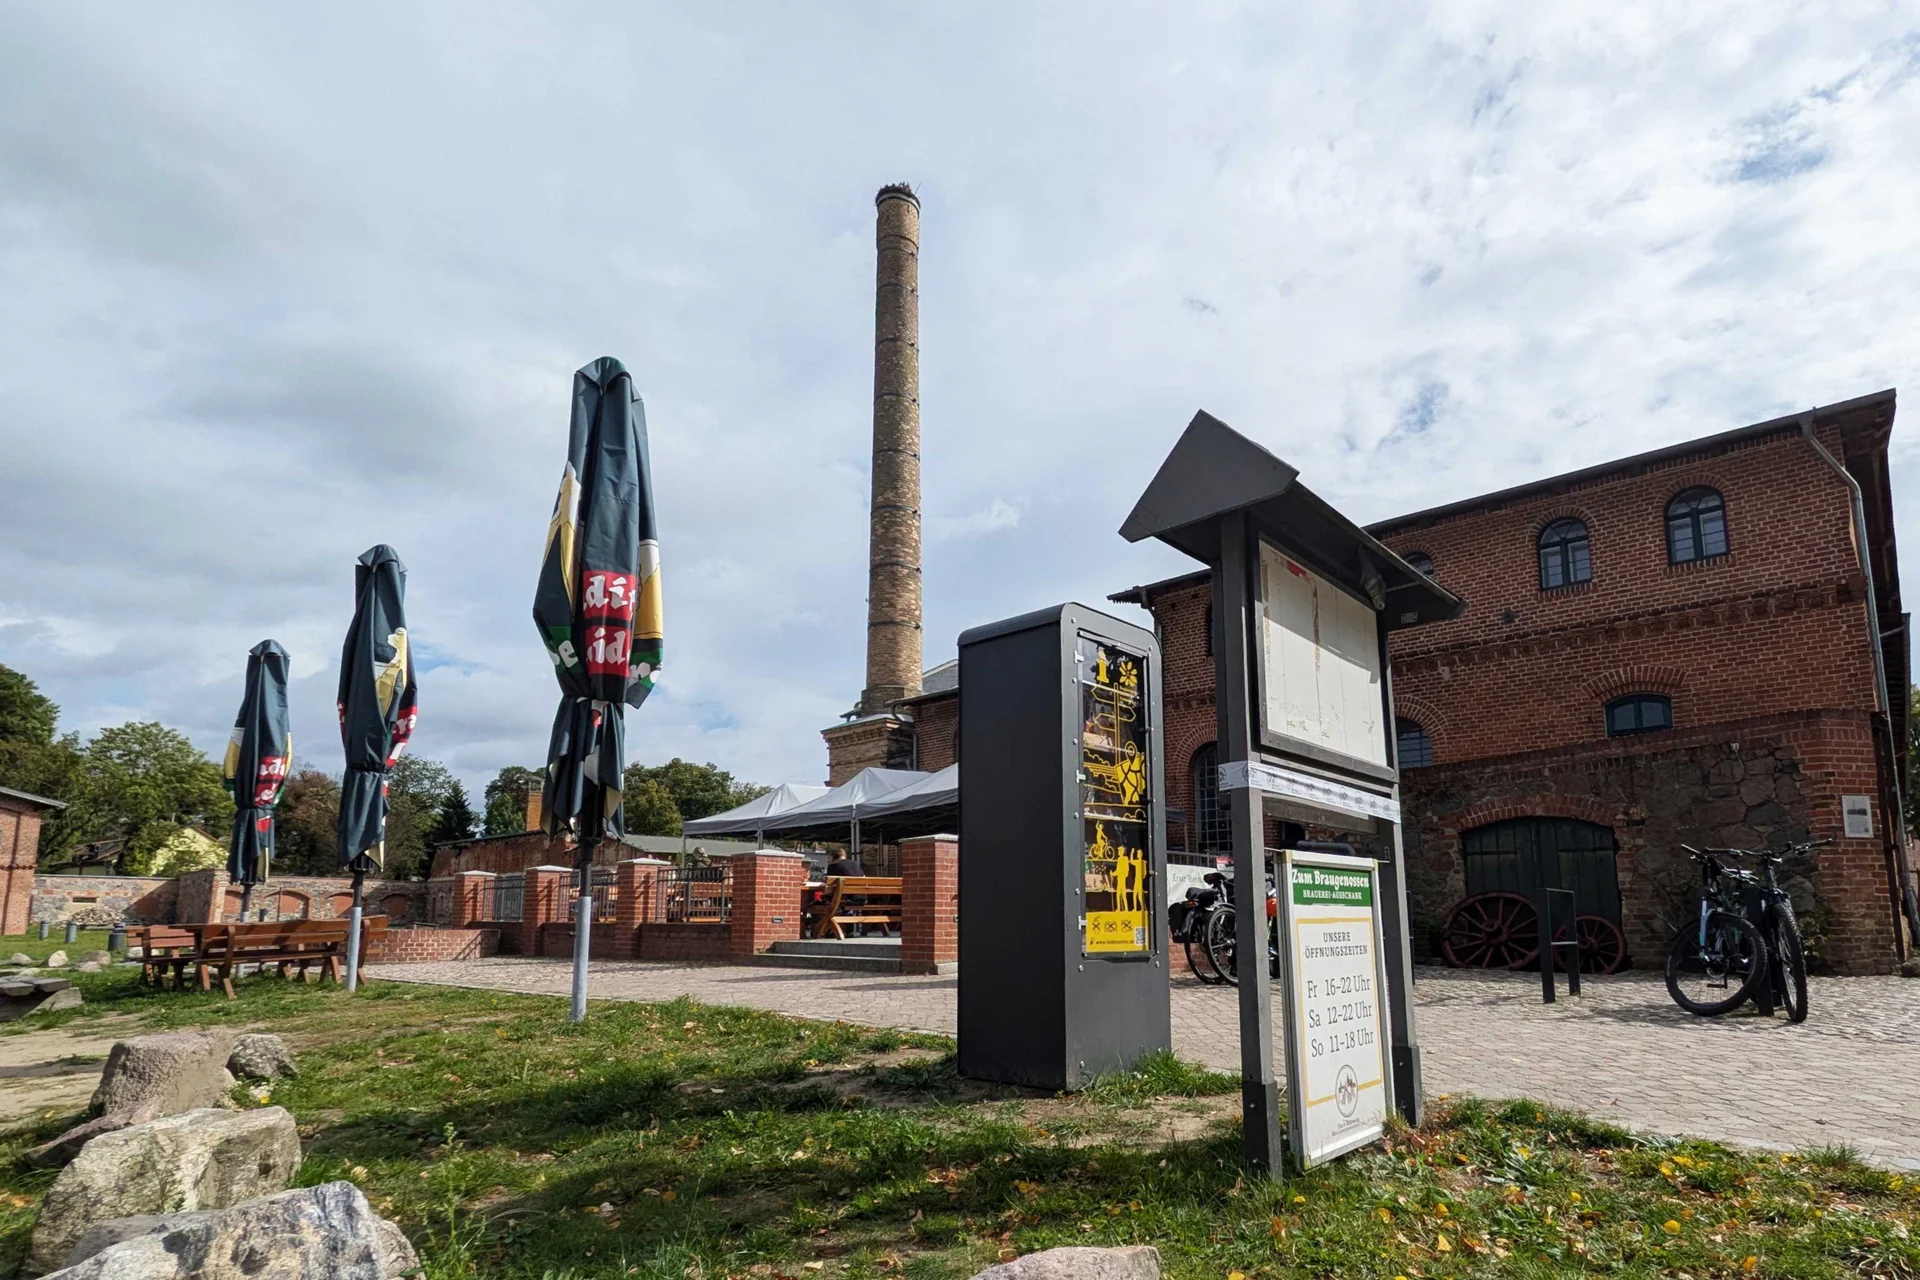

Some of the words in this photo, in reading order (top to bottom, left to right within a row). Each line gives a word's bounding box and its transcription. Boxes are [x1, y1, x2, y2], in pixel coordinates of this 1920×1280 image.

[1292, 869, 1313, 885] Zum
[1313, 870, 1370, 890] Braugenossen
[1303, 889, 1362, 900] BRAUEREI-AUSSCHANK
[1323, 931, 1351, 943] UNSERE
[1304, 944, 1368, 958] ÖFFNUNGSZEITEN
[1307, 980, 1318, 998] Fr
[1353, 974, 1370, 992] Uhr
[1309, 1009, 1321, 1028] Sa
[1355, 1000, 1372, 1019] Uhr
[1311, 1038, 1324, 1057] So
[1357, 1027, 1374, 1046] Uhr
